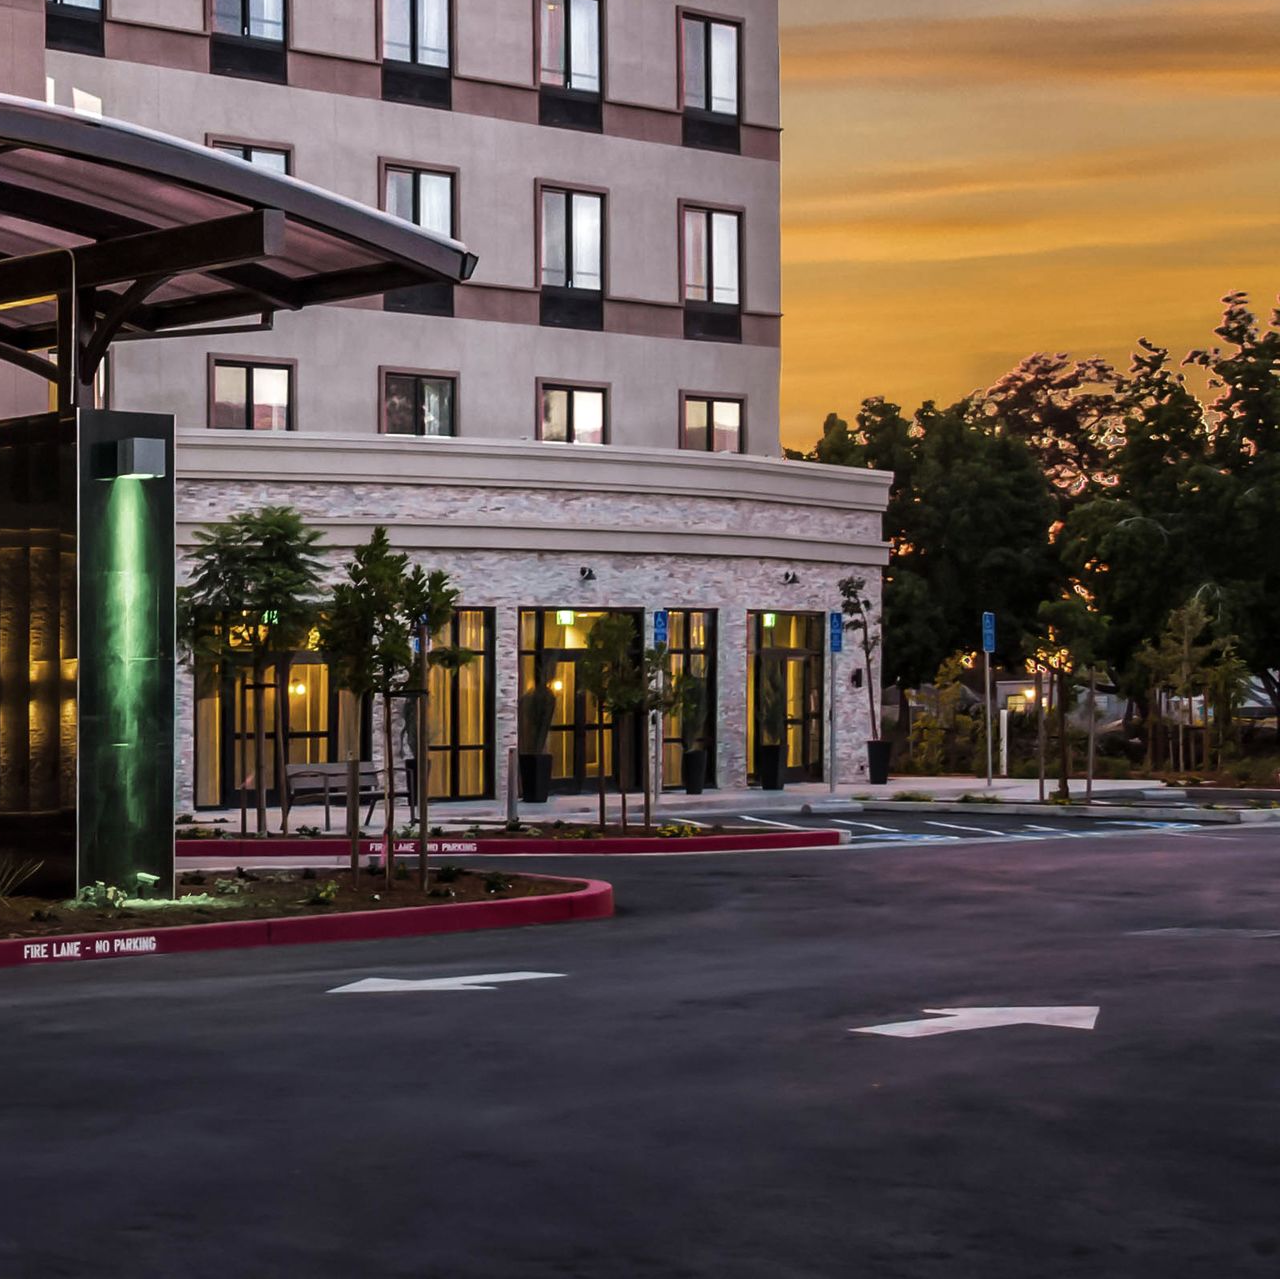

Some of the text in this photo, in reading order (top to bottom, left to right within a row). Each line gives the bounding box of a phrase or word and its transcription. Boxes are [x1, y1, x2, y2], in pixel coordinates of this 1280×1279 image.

[441, 842, 478, 852] PARKING
[23, 943, 49, 959] FIRE
[53, 941, 81, 957] LANE
[95, 939, 110, 953] NO
[114, 936, 157, 952] PARKING
